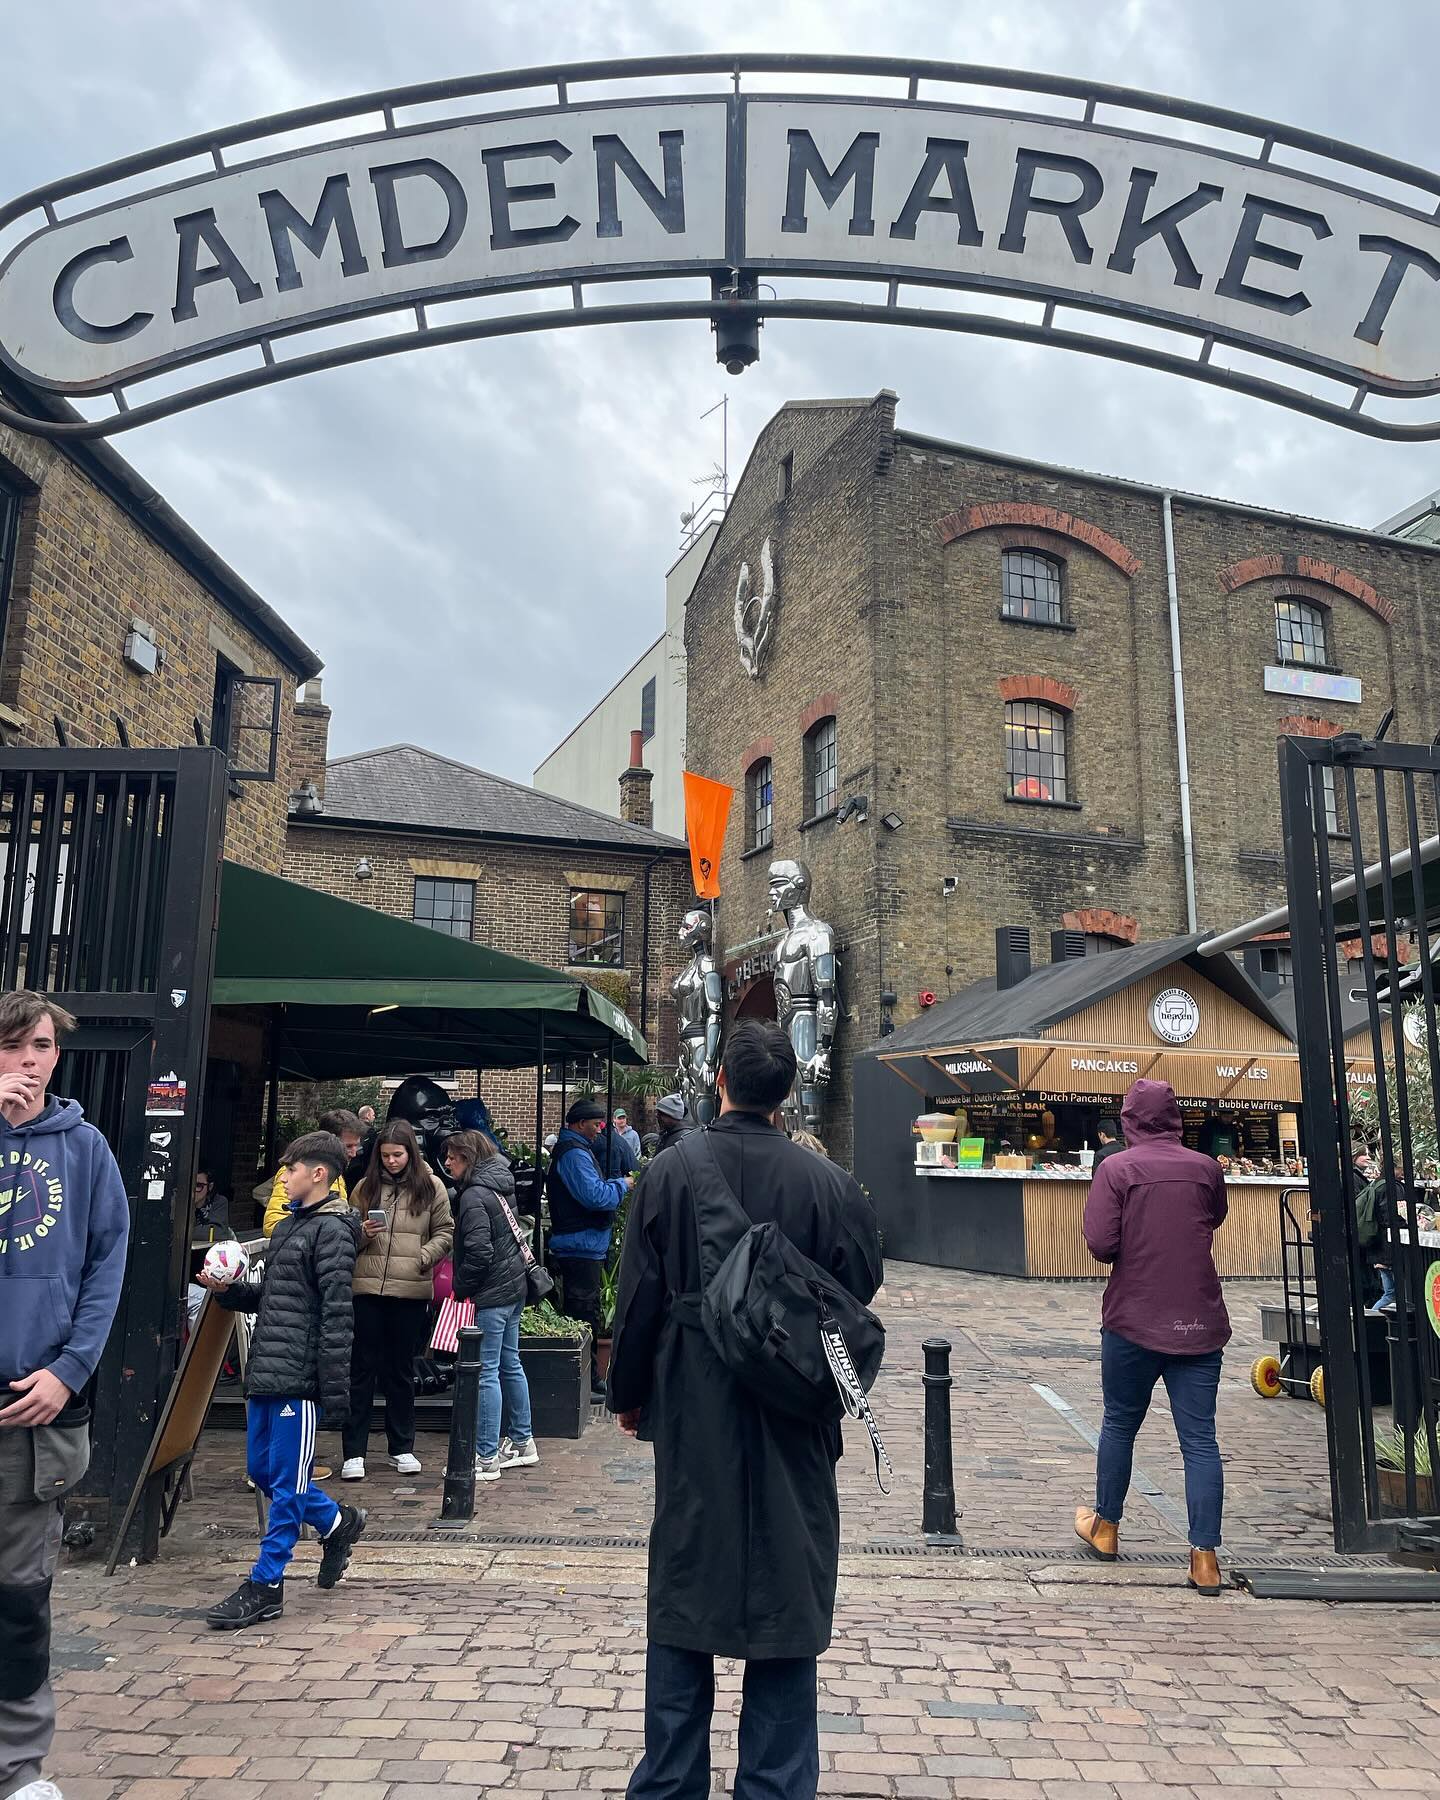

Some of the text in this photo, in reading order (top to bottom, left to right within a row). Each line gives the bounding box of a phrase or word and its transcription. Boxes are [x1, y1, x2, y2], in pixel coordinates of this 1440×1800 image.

[53, 128, 1440, 346] CAMDEN MARKET
[1161, 1012, 1192, 1020] heaven
[1071, 1059, 1138, 1073] PANCAKES
[1216, 1065, 1268, 1080] WAFLES
[974, 1093, 992, 1103] Dutch
[1040, 1092, 1112, 1104] Dutch Pancakes
[1218, 1100, 1283, 1111] Bubble Waffles
[33, 1158, 50, 1177] IT.
[46, 1177, 63, 1212] JUST
[35, 1214, 57, 1237] DO
[1173, 1318, 1207, 1336] Rapha
[829, 1333, 867, 1409] MONSTER
